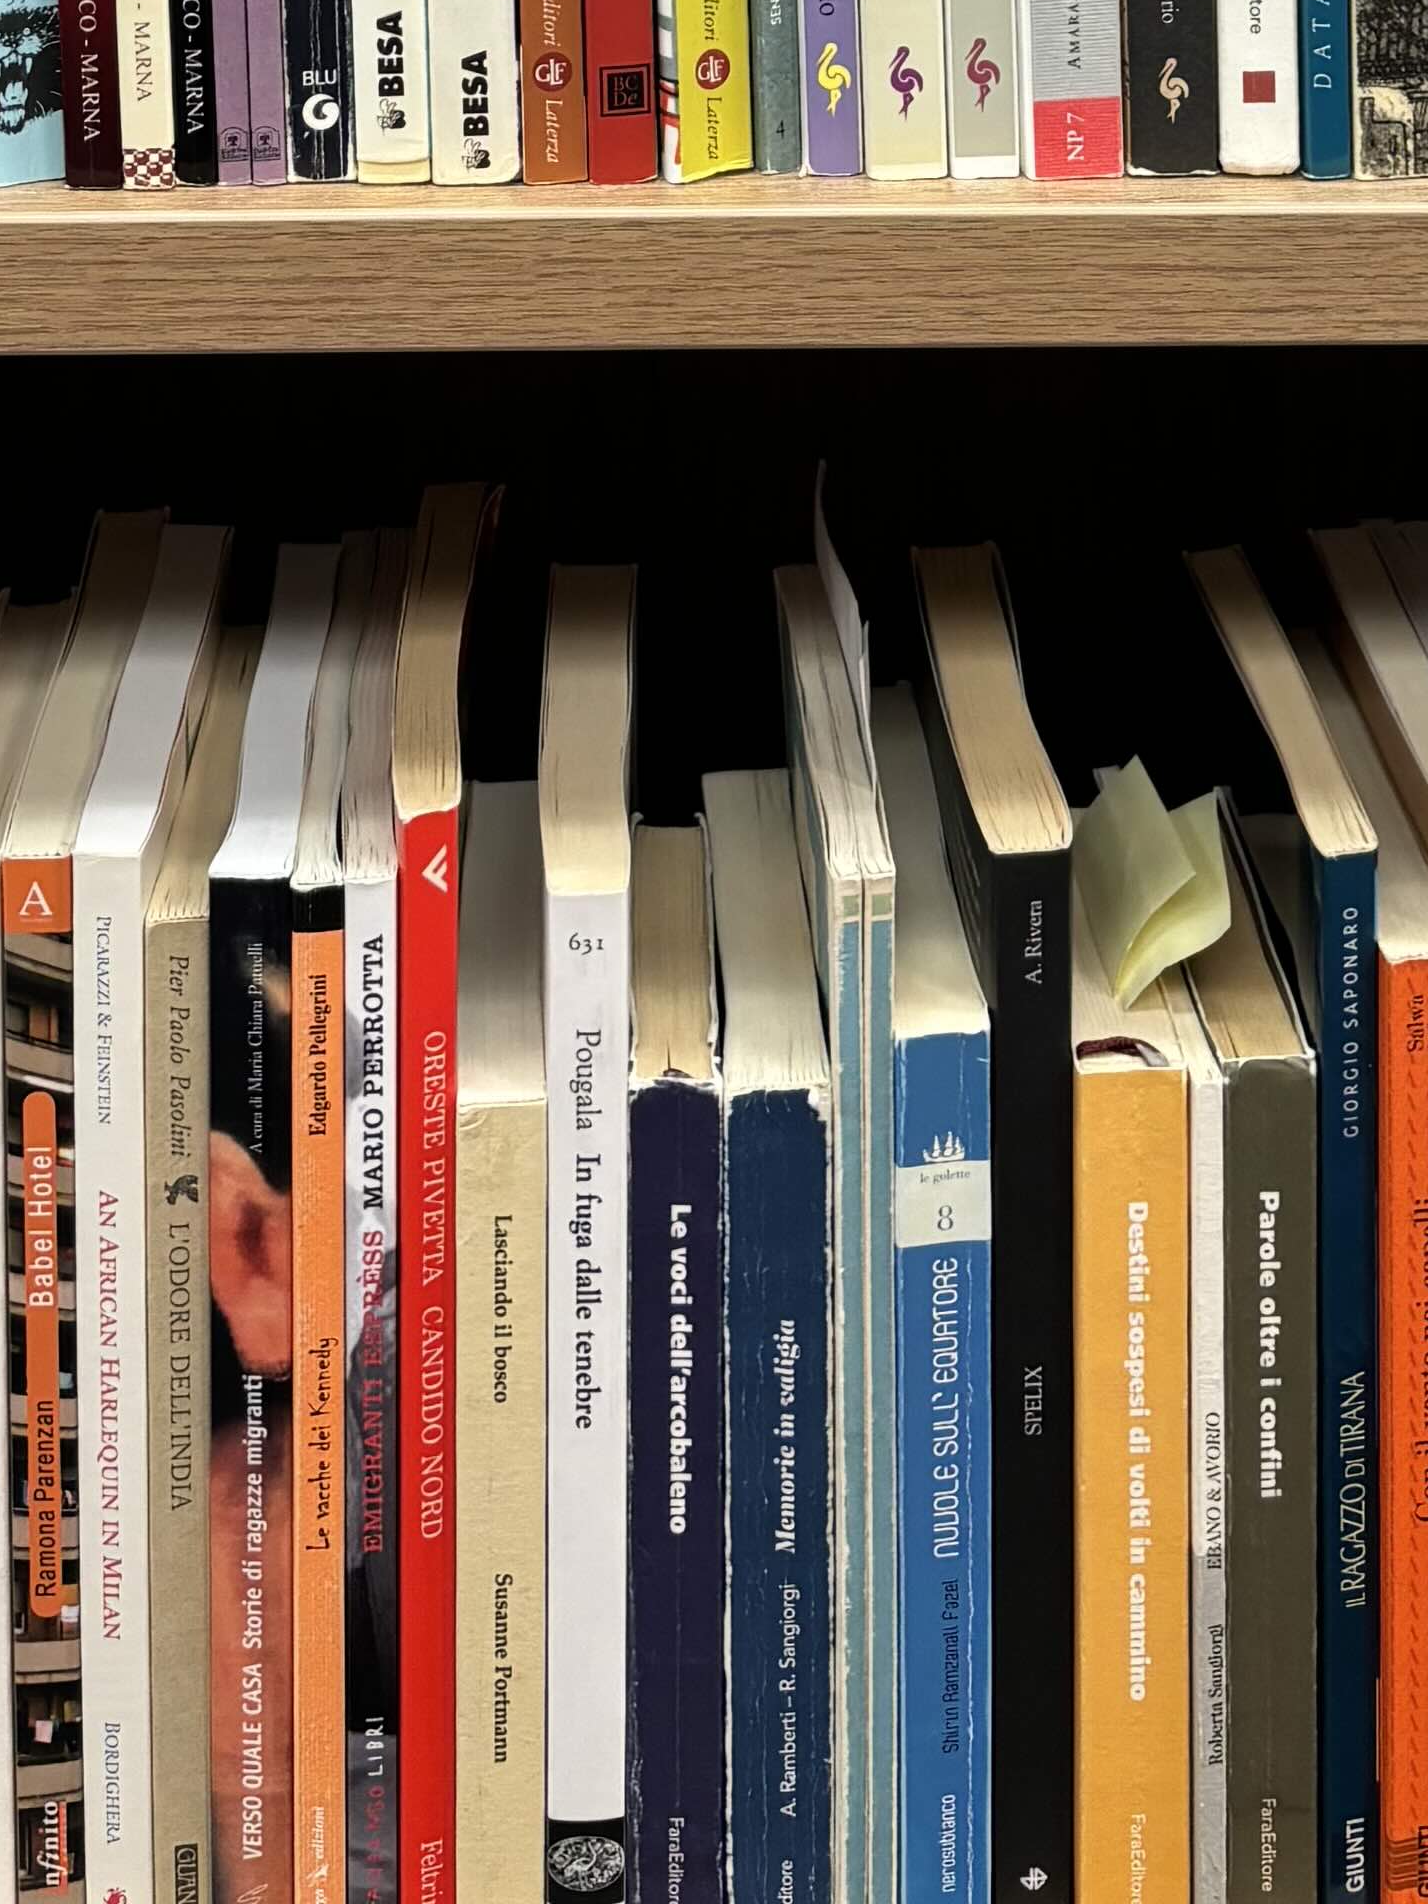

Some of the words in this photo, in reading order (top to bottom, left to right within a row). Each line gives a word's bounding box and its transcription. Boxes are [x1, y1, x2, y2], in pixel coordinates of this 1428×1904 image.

[424, 1031, 446, 1149] ORESTE
[576, 1154, 601, 1182] In
[423, 1158, 445, 1286] PIVETTA
[569, 1193, 602, 1248] fuga
[1259, 1191, 1281, 1287] Parole
[576, 1259, 602, 1319] dalle
[1260, 1297, 1281, 1367] oltre
[421, 1306, 444, 1444] CANDIDO
[575, 1331, 602, 1429] tenebre
[1260, 1378, 1281, 1386] i
[1260, 1397, 1282, 1498] confini
[421, 1453, 443, 1538] NORD
